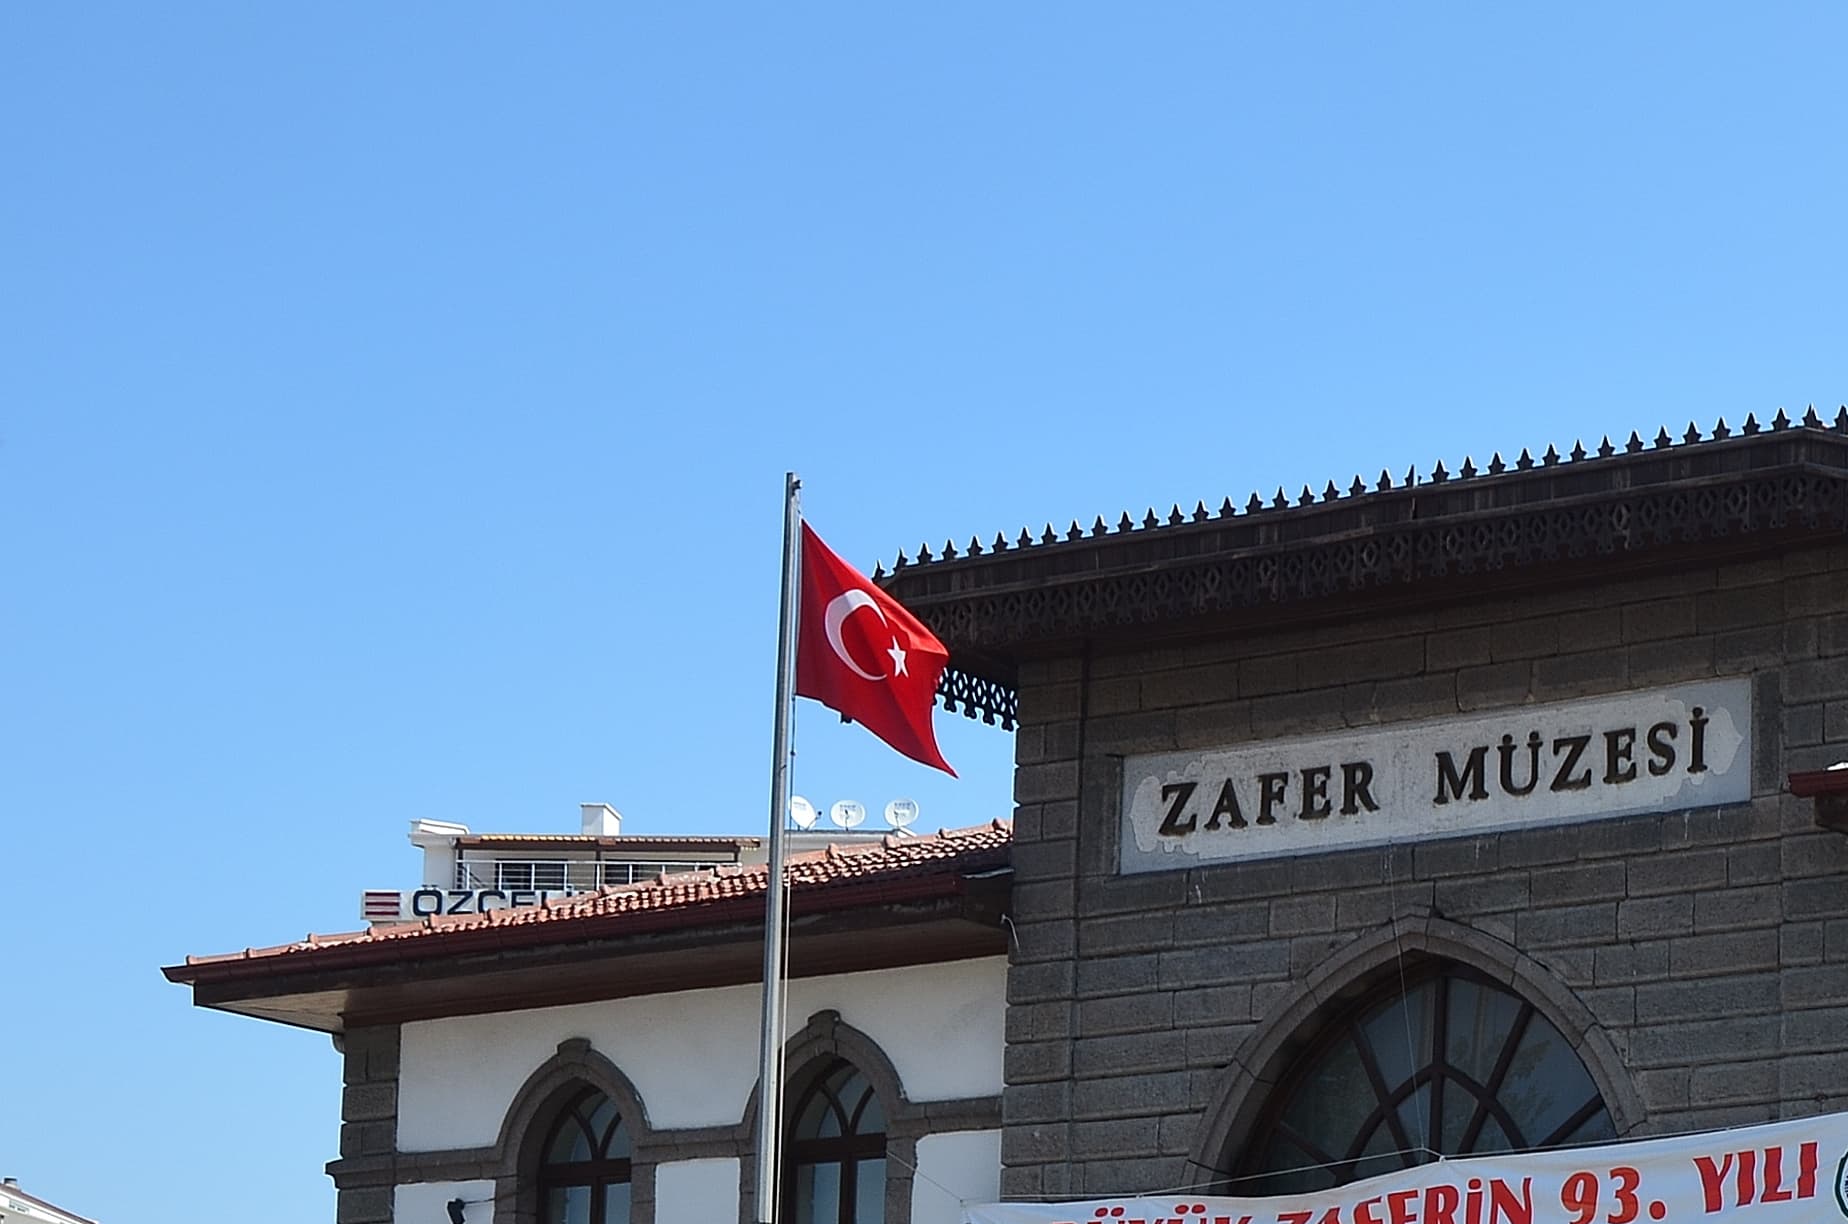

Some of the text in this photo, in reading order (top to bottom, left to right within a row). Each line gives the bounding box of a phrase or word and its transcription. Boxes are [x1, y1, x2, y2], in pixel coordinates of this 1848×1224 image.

[1158, 706, 1709, 836] ZAFER MÜZESİ
[1693, 1141, 1818, 1213] YILI
